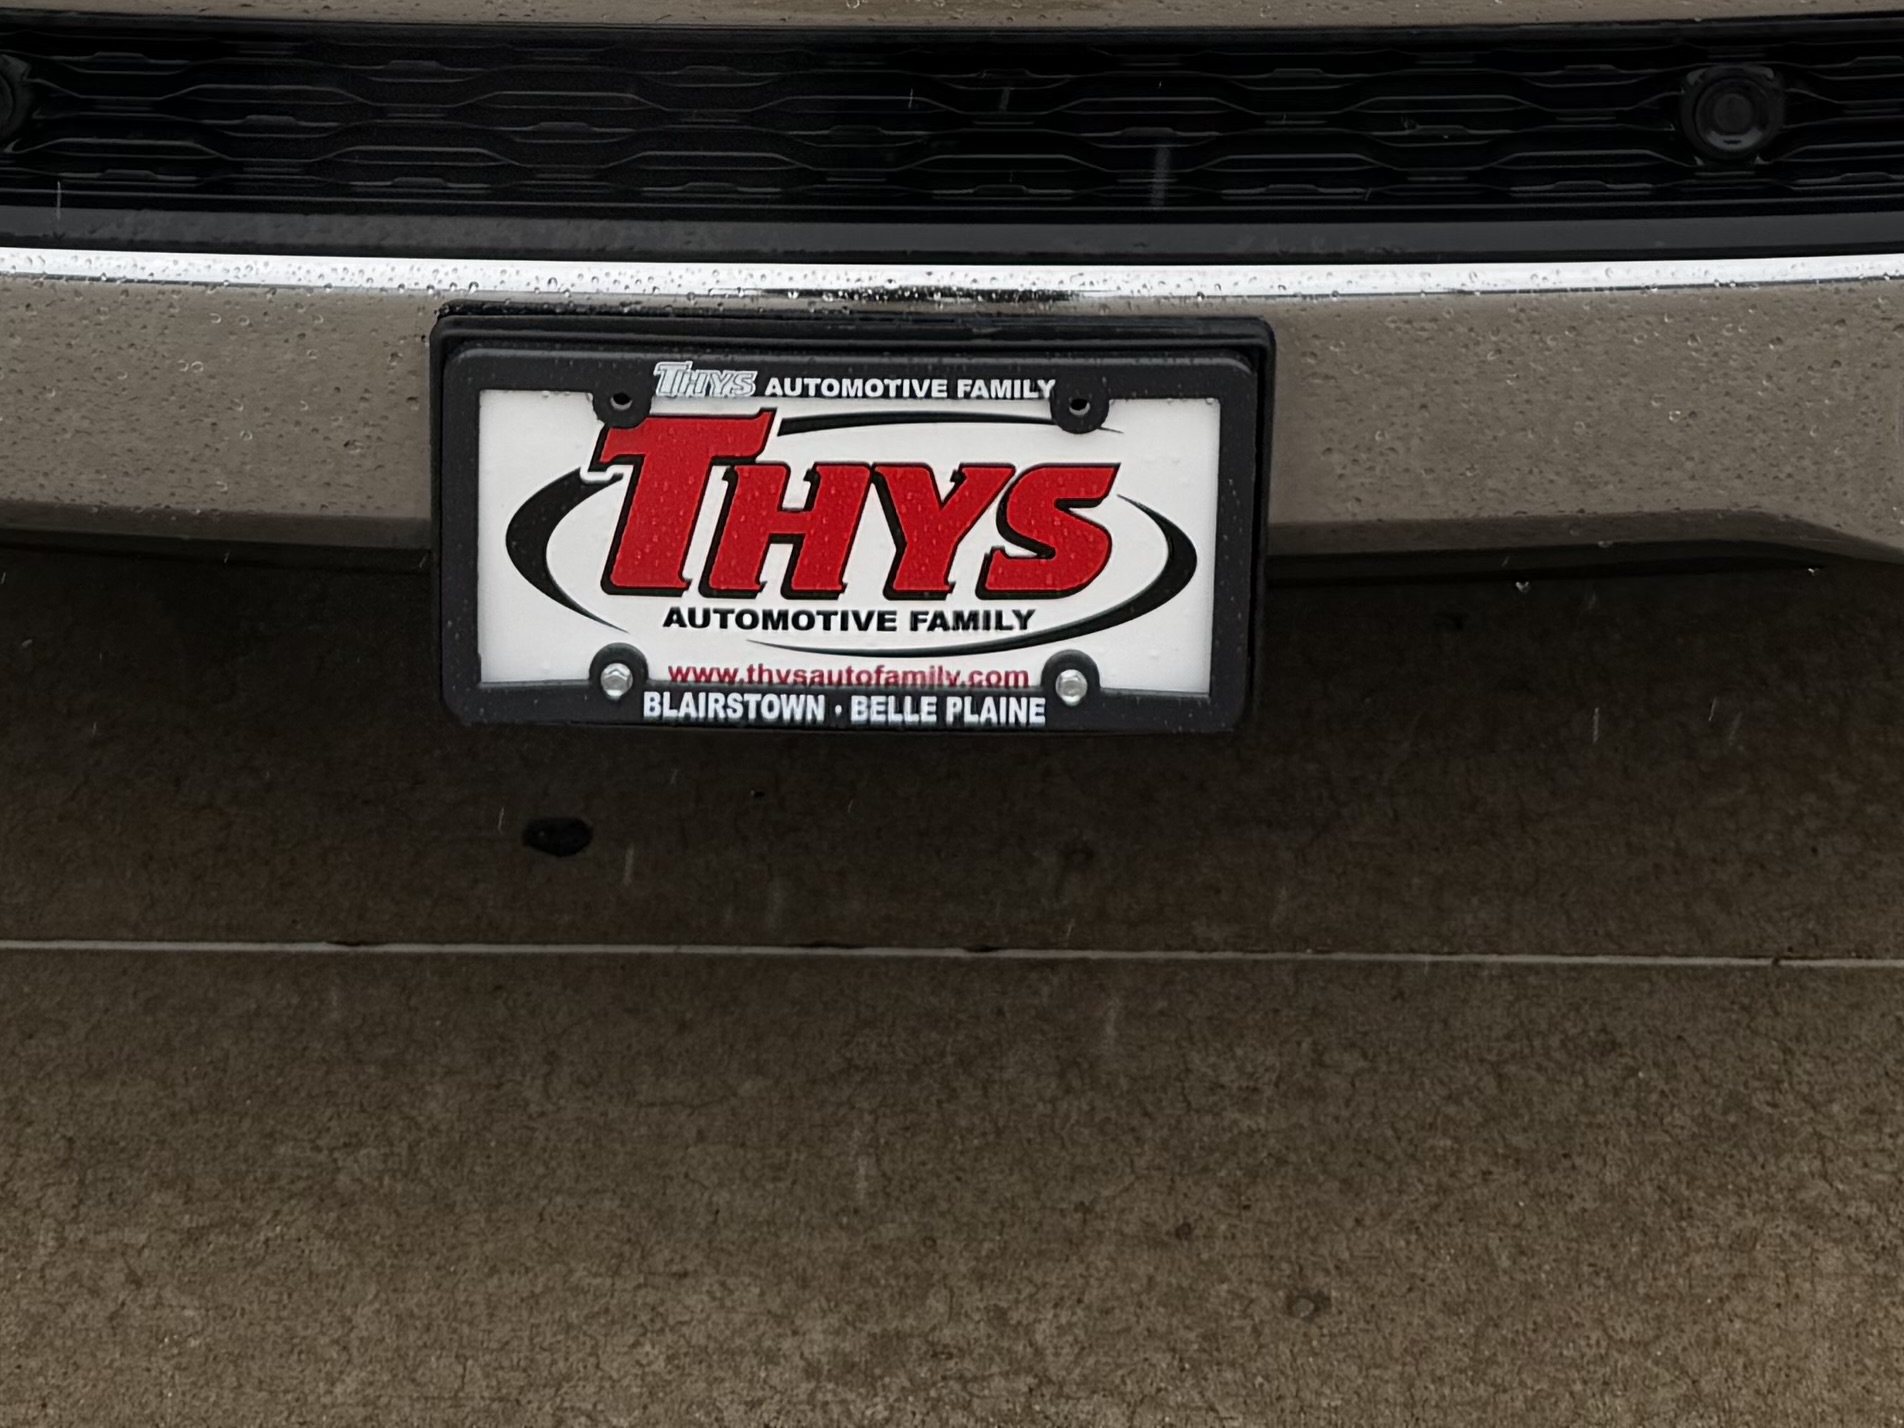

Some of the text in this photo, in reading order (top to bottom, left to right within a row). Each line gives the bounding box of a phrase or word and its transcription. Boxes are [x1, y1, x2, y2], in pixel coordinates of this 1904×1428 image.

[653, 360, 1056, 400] THYS AUTOMOTIVE FAMILY
[587, 407, 1122, 600] THYS
[662, 606, 1037, 632] AUTOMOTIVE FAMILY
[642, 690, 1047, 727] BLAIRSTOWN BELLE PLAINE
